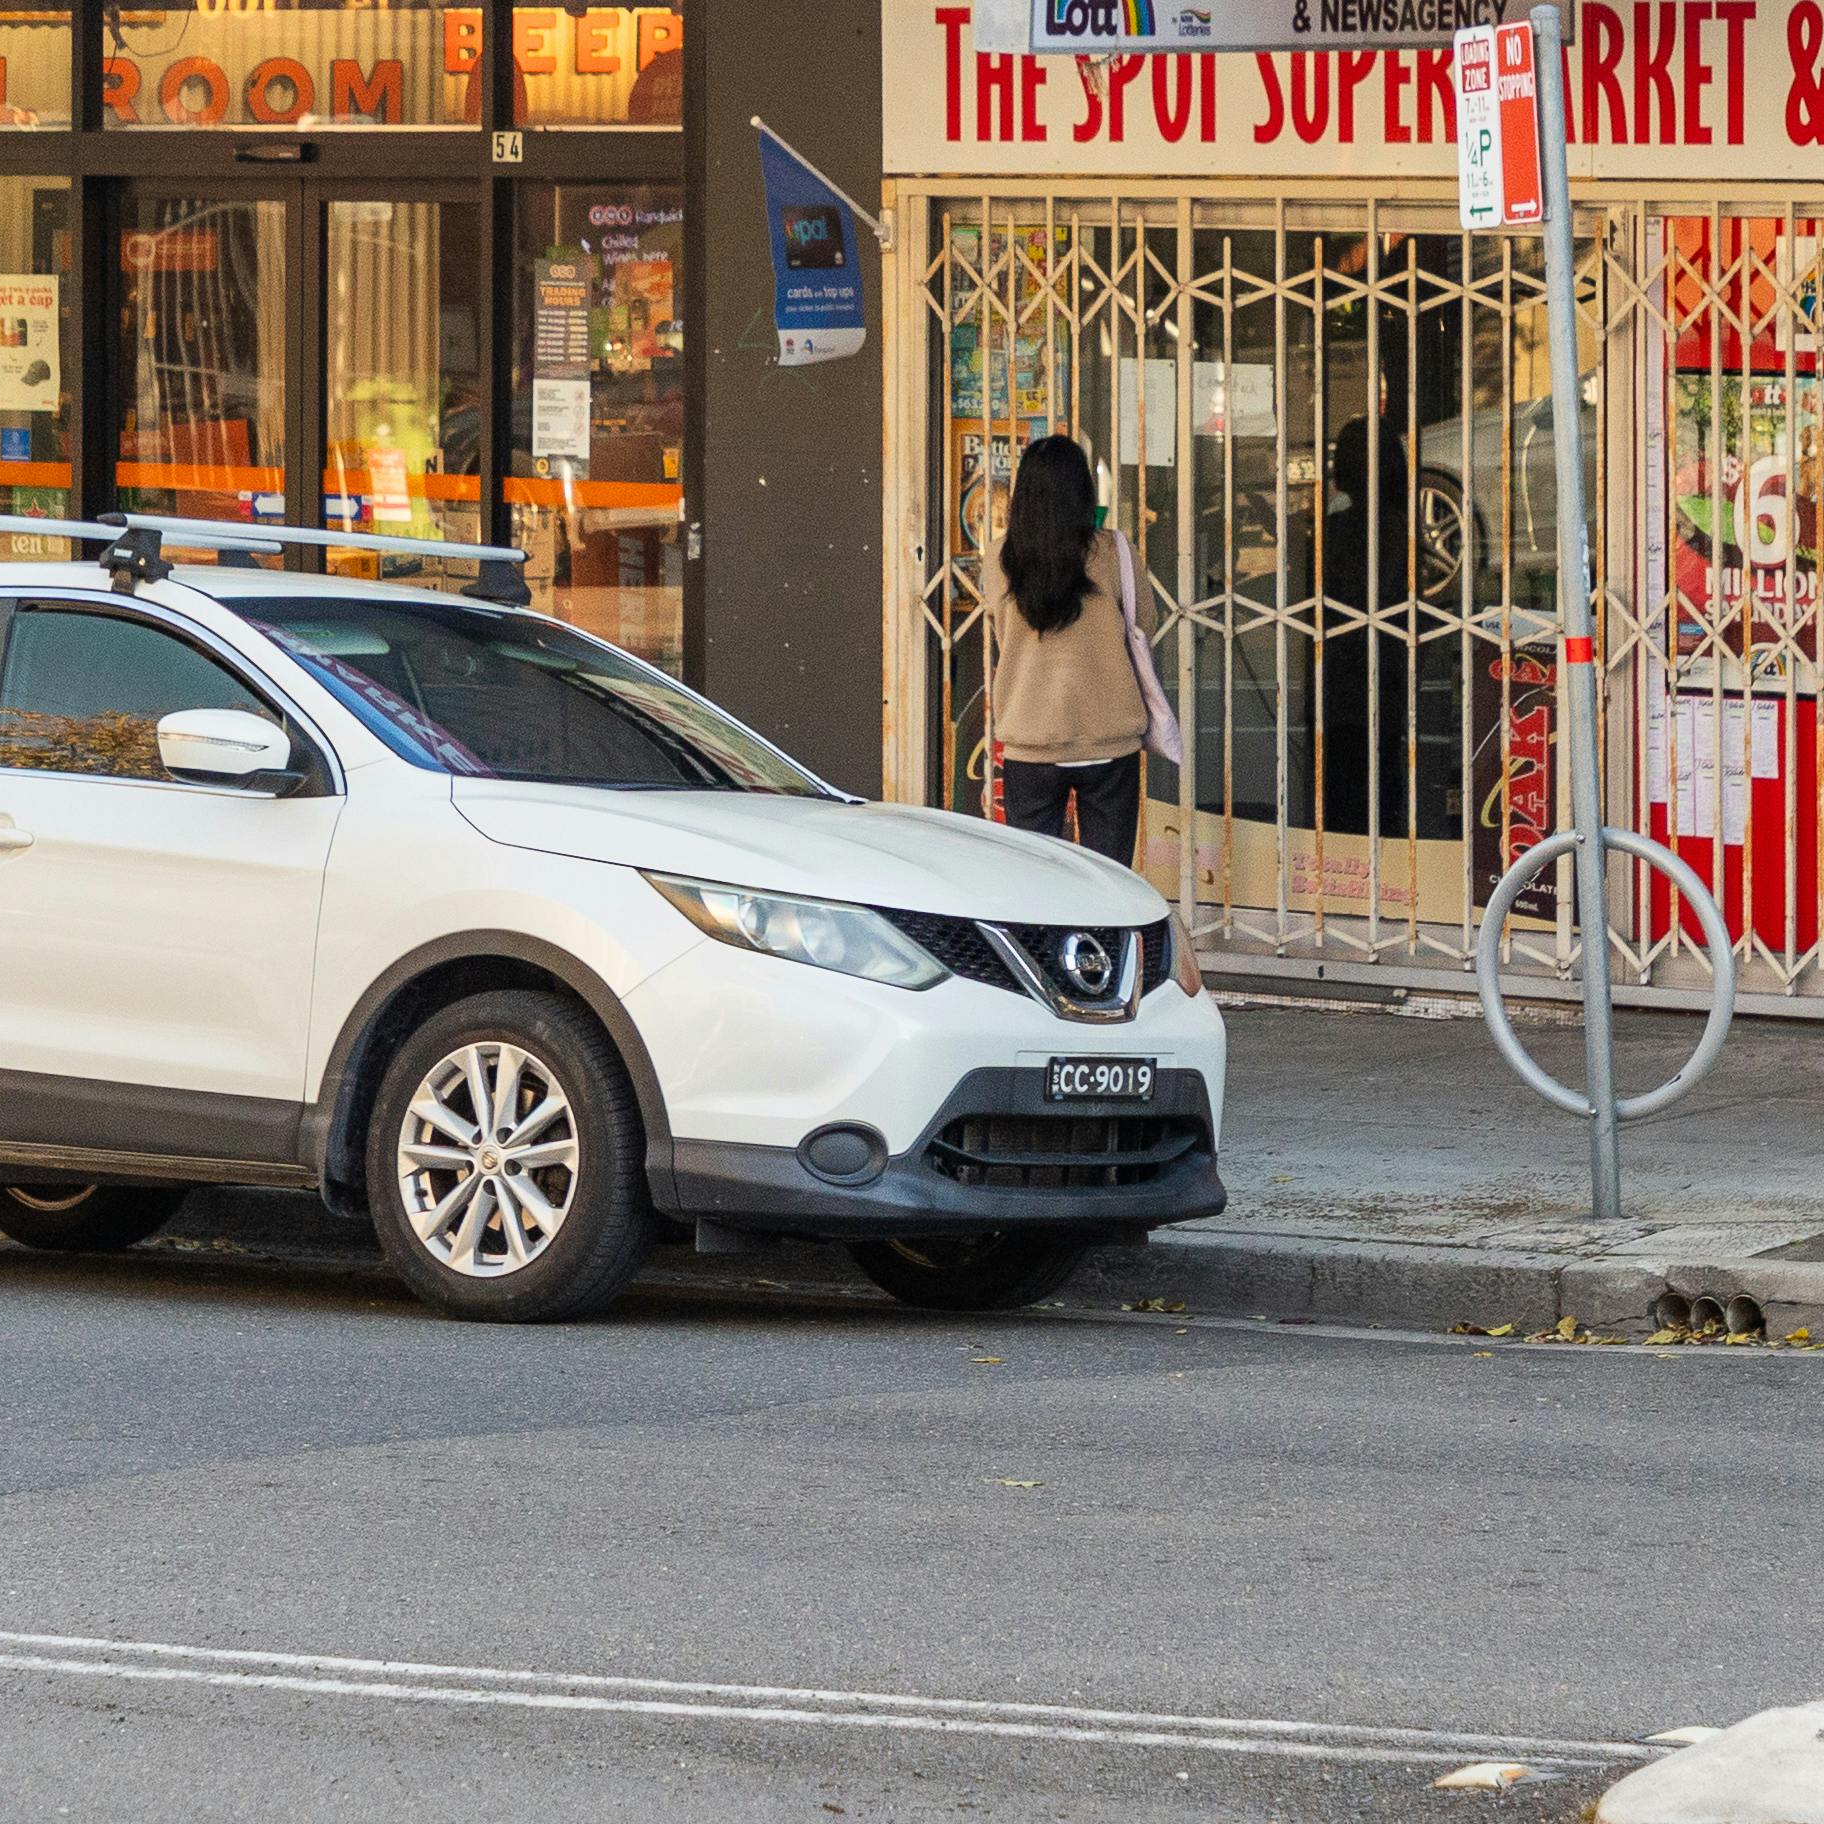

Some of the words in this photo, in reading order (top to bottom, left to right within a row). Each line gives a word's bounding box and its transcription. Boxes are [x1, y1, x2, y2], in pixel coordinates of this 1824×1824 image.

[1292, 0, 1312, 33] &
[1460, 40, 1490, 65] LOADING
[1505, 35, 1522, 67] NO
[935, 6, 1048, 143] THE
[1252, 1, 1757, 147] SUPERRKET
[1463, 67, 1489, 91] ZONE
[1498, 72, 1534, 101] STOPPING
[495, 135, 521, 160] 54
